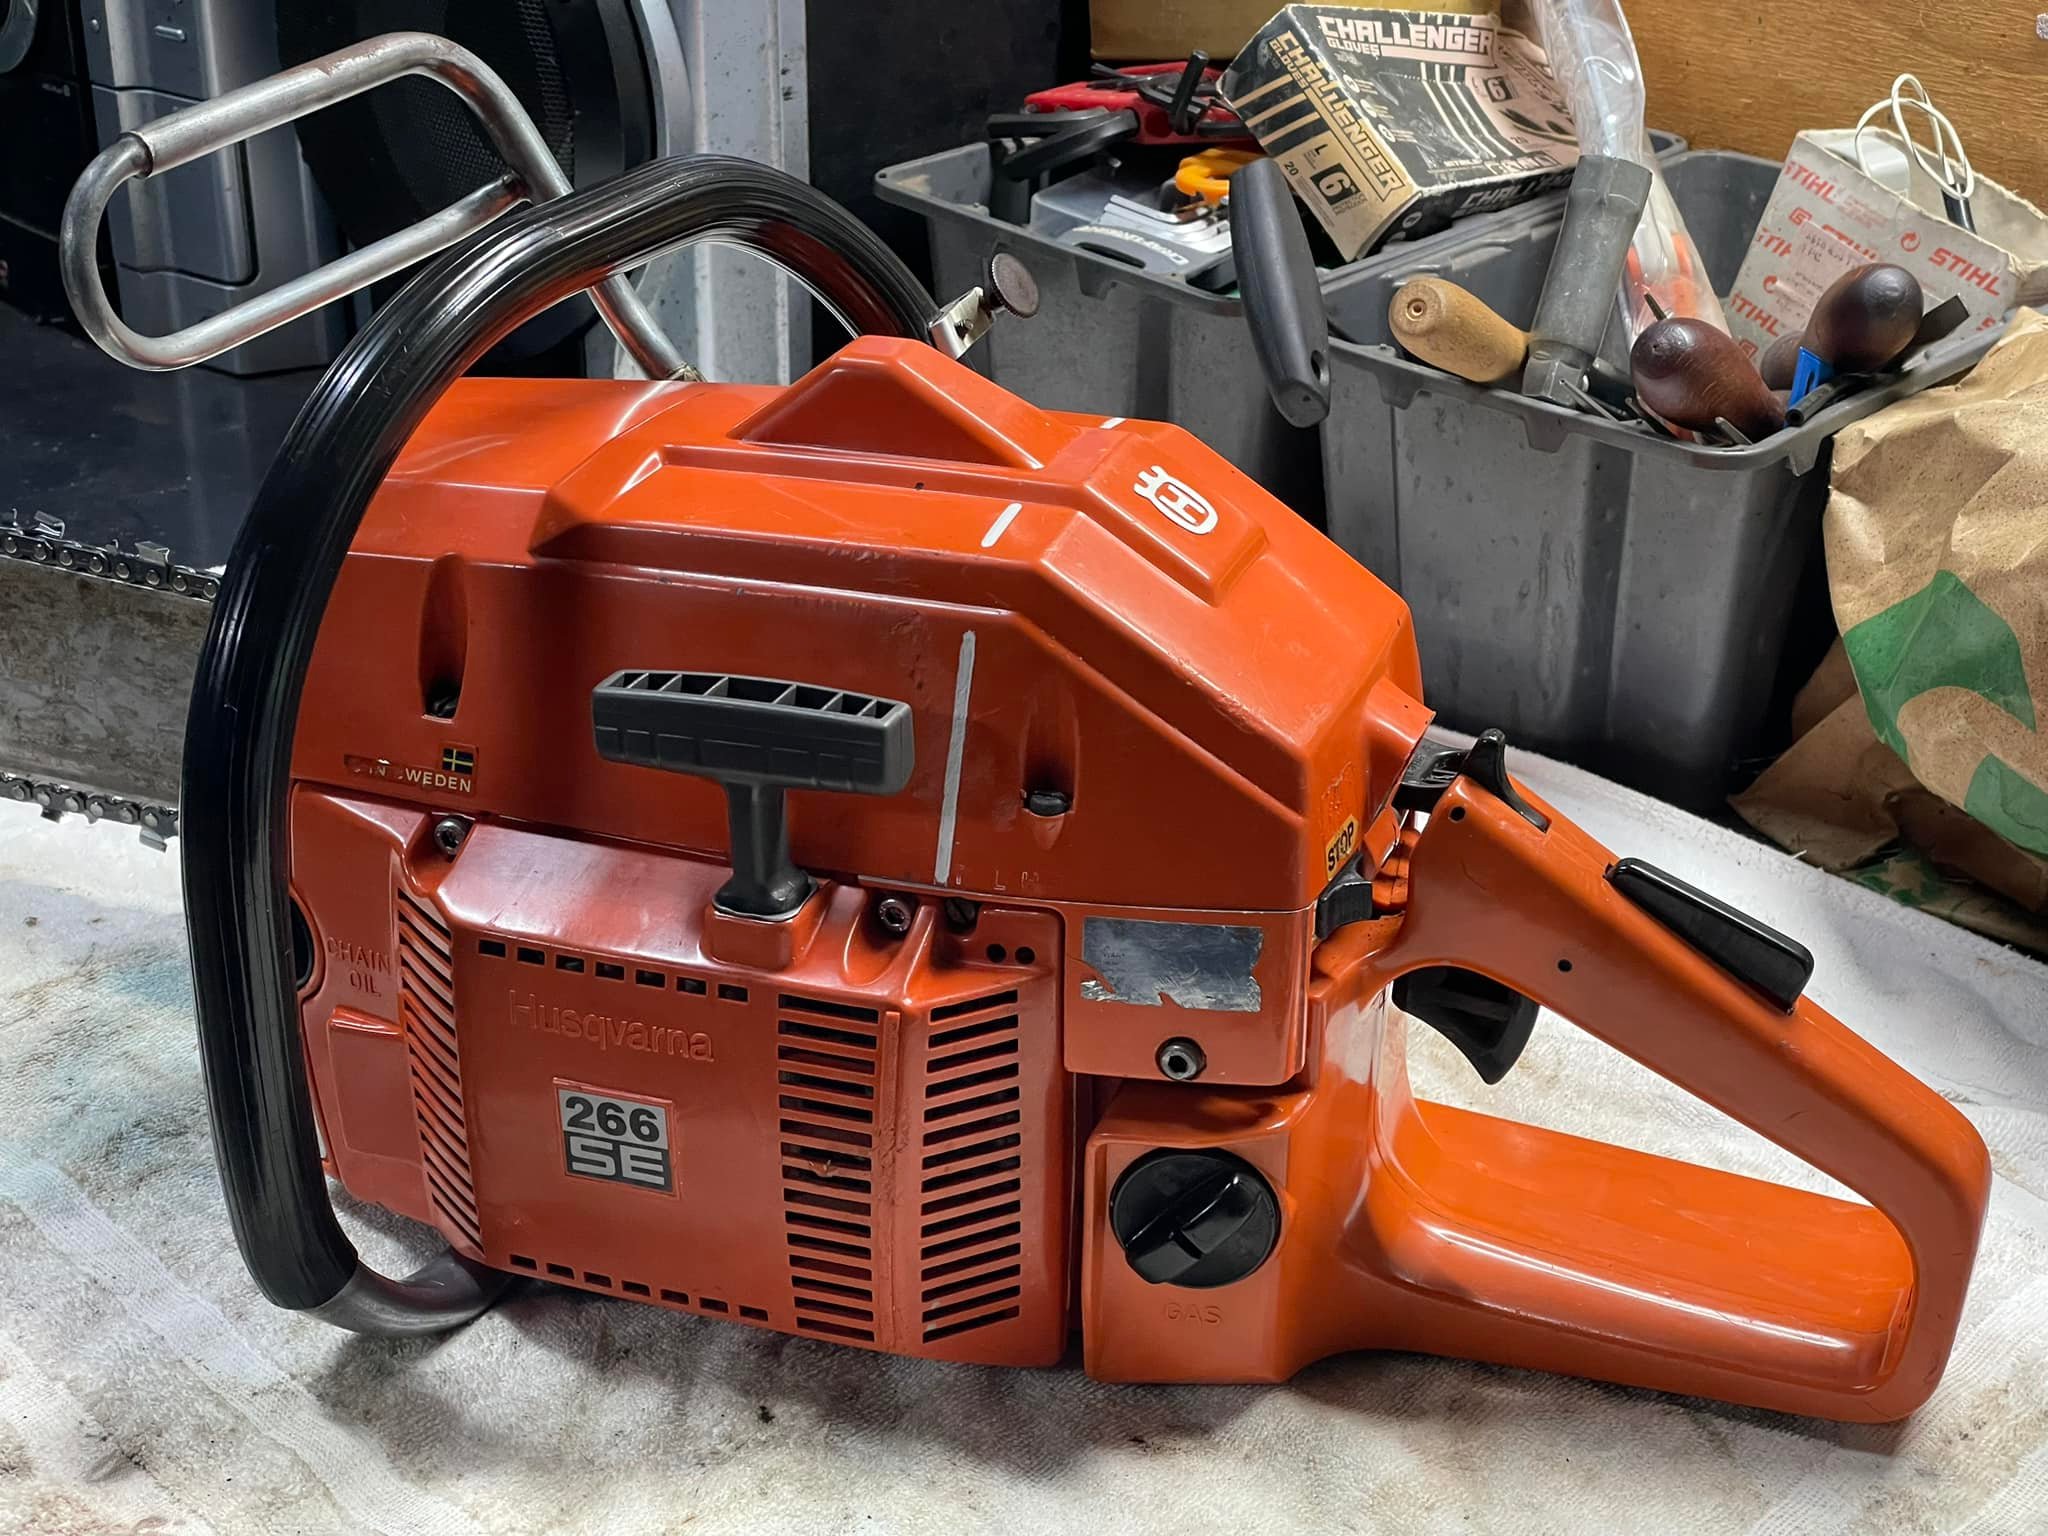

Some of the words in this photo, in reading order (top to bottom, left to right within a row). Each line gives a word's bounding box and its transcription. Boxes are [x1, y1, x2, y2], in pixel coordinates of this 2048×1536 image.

[1316, 15, 1495, 54] CHALLENGER
[1326, 36, 1380, 57] GLOVES
[1269, 39, 1309, 89] GLOVES
[1276, 30, 1405, 199] CHALLENGER
[1284, 161, 1299, 176] 20
[1314, 143, 1329, 155] L
[1319, 171, 1352, 197] 6
[1754, 228, 1792, 258] TIH
[1928, 247, 2001, 297] STIHL
[398, 766, 472, 793] WEDEN
[1328, 820, 1355, 873] STOP
[326, 936, 392, 976] CHAIN
[350, 969, 382, 998] OIL
[509, 989, 715, 1062] Husqvarna
[565, 1096, 661, 1143] 266
[569, 1135, 666, 1186] SE
[1162, 1300, 1224, 1327] GAS
